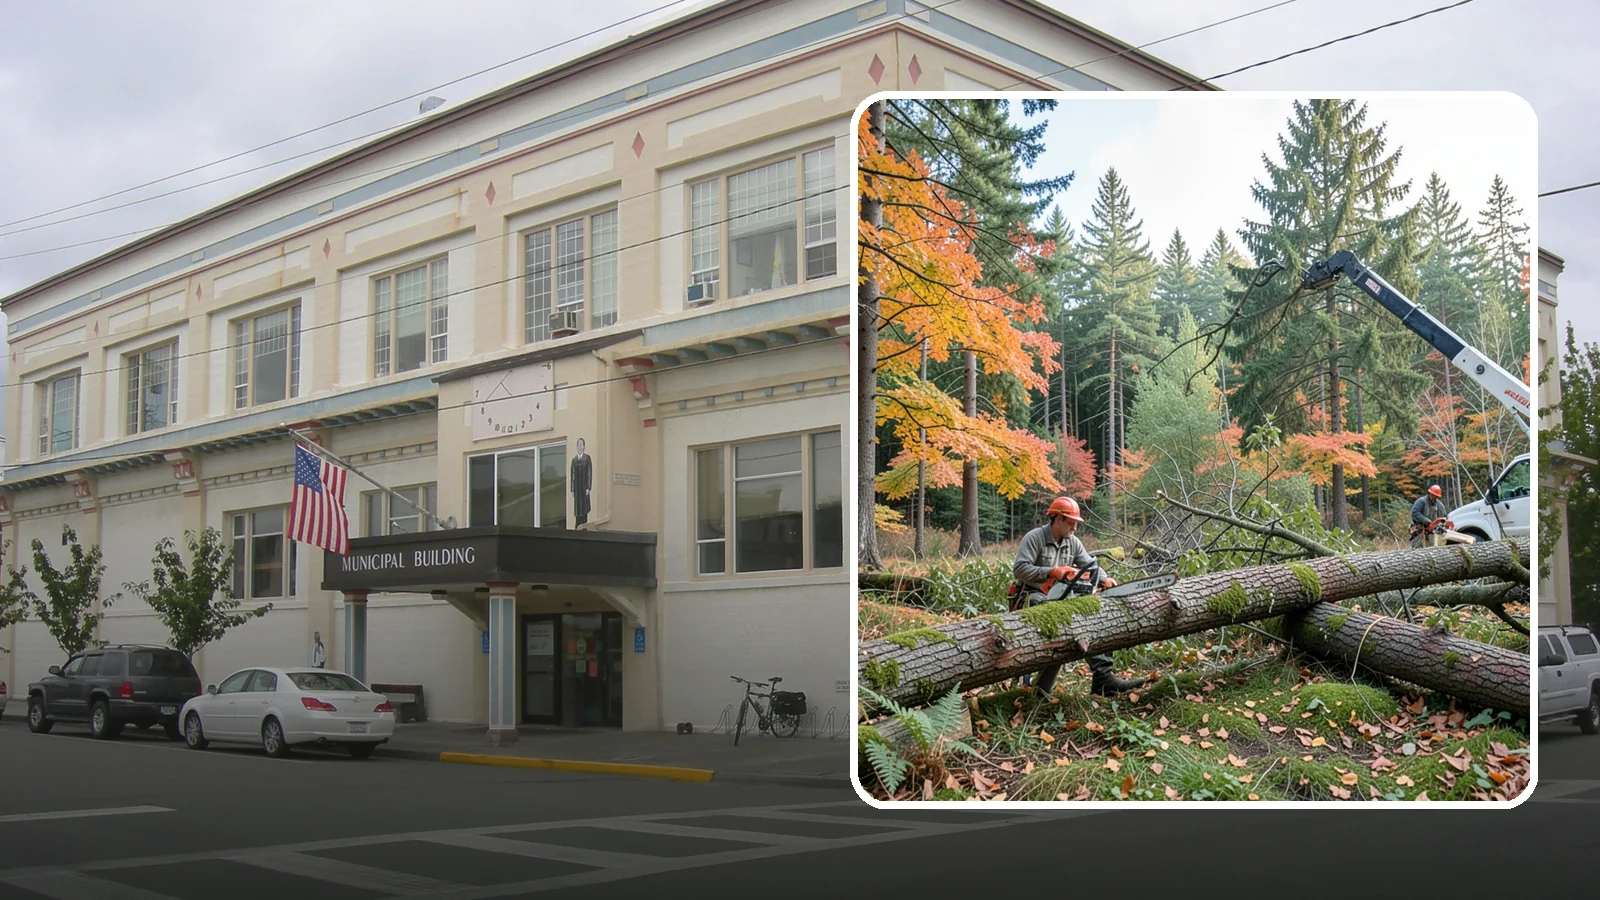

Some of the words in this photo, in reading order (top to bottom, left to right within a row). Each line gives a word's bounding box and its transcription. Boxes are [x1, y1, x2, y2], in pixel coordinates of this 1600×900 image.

[481, 407, 485, 415] 8
[529, 414, 533, 422] 3
[342, 552, 405, 572] MUNICIPAL
[414, 546, 475, 567] BUILDING
